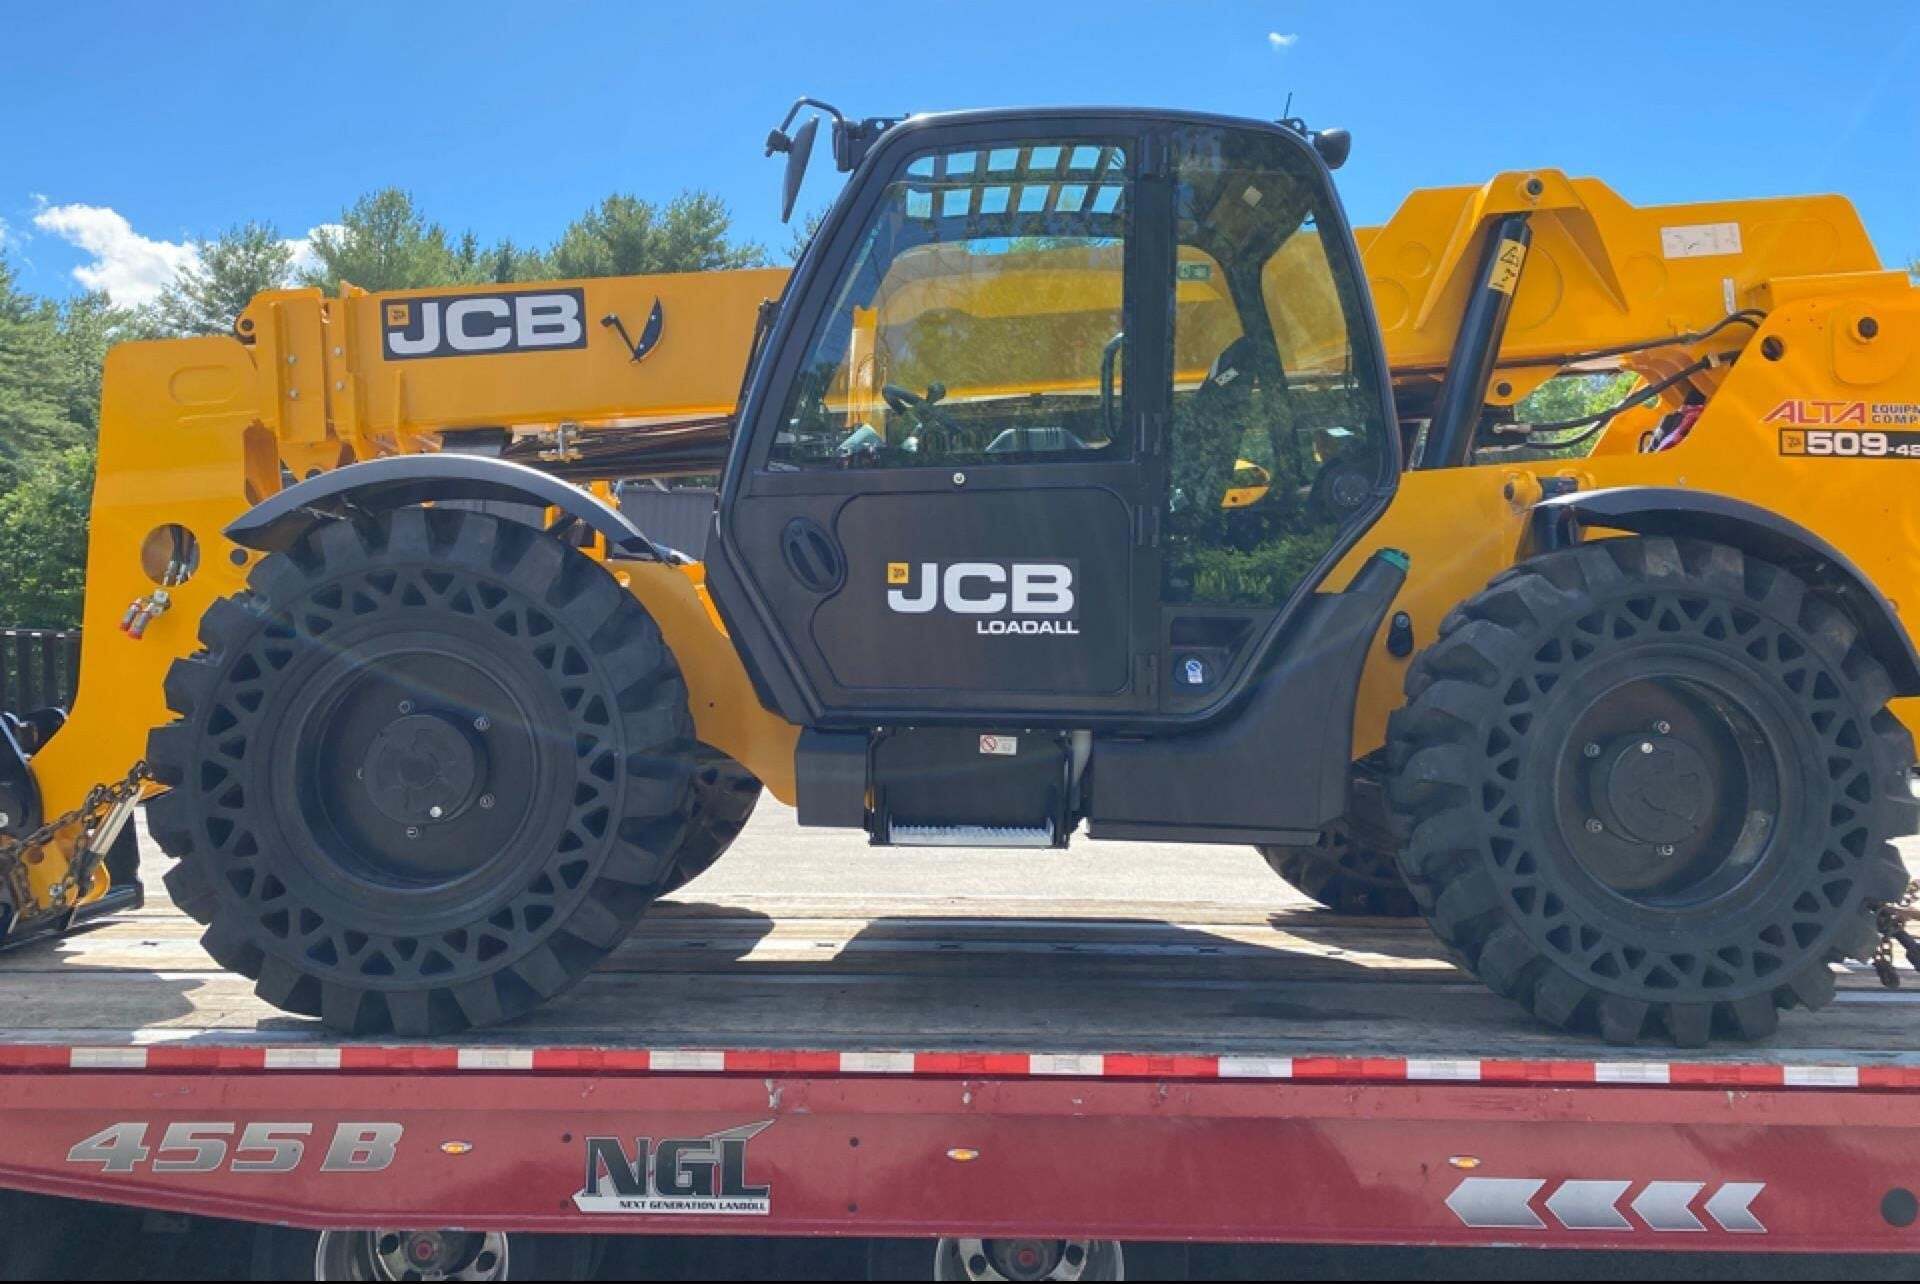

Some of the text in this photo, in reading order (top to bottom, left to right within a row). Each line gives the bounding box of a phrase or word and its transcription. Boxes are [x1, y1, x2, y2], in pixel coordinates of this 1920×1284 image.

[388, 294, 582, 354] JCB
[1763, 399, 1865, 424] ALTA
[887, 562, 1075, 614] JCB
[976, 620, 1080, 634] LOADALL
[66, 1122, 404, 1172] 455 B
[584, 1135, 771, 1199] NGL
[619, 1200, 646, 1209] NEXT
[650, 1200, 716, 1210] GENERATION
